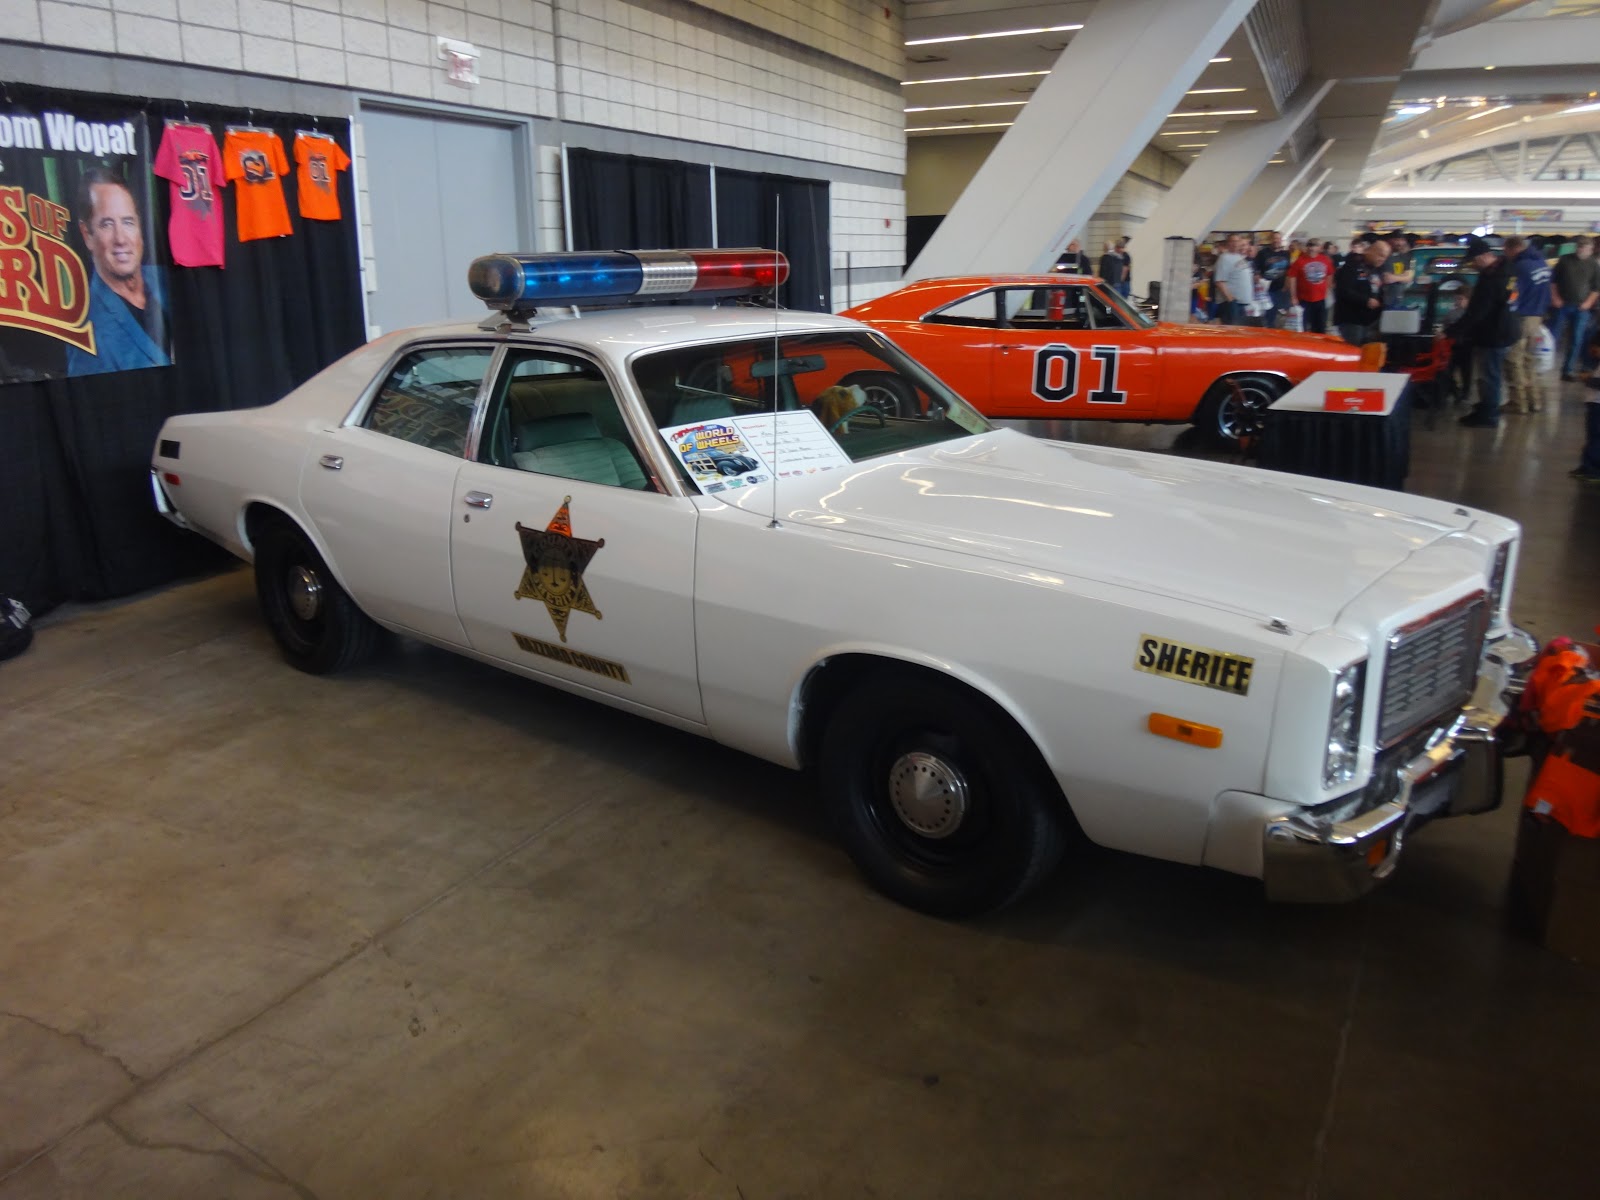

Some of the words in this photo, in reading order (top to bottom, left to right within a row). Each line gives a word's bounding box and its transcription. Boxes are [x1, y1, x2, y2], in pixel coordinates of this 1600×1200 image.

[0, 115, 44, 150] om
[43, 112, 138, 157] Wopat
[0, 185, 30, 247] S
[26, 193, 71, 241] OF
[0, 229, 90, 328] RD
[1031, 343, 1128, 405] 01
[679, 442, 693, 453] OF
[696, 434, 740, 450] WHEELS
[695, 426, 735, 441] WORLD
[1138, 638, 1254, 691] SHERIFF
